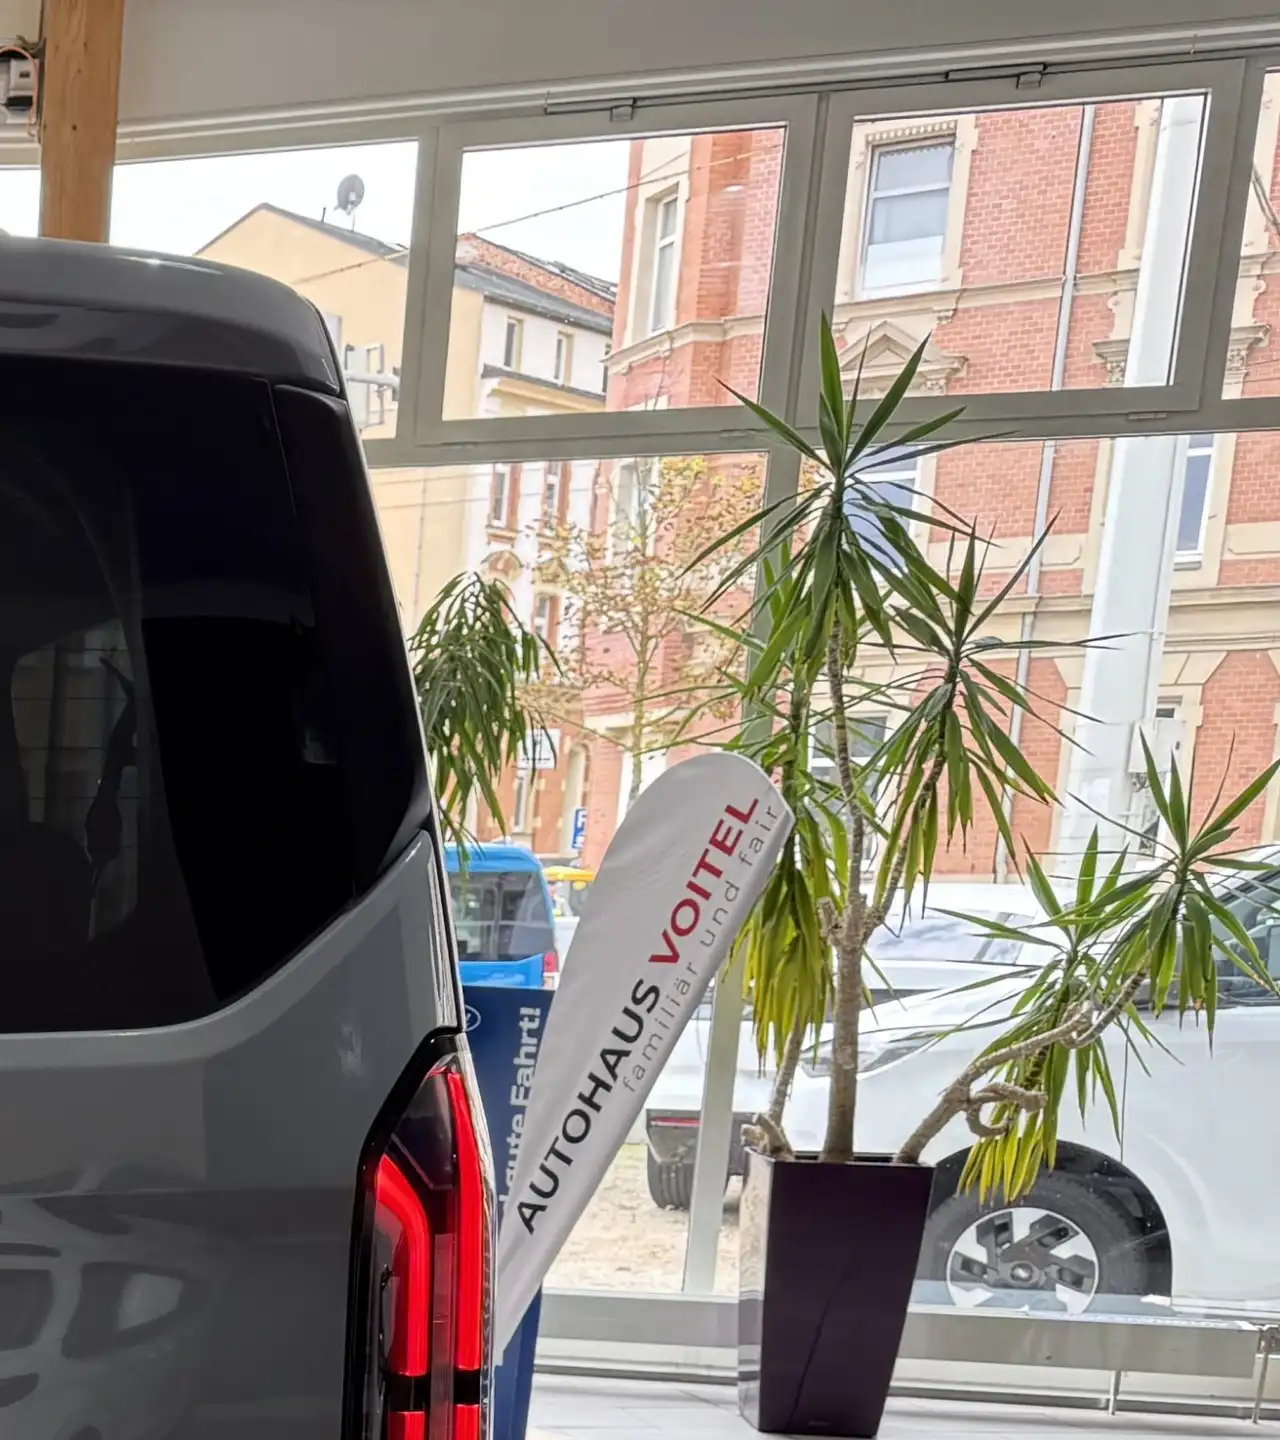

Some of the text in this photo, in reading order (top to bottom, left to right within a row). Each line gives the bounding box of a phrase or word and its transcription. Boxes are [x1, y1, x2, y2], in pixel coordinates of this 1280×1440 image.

[510, 1007, 541, 1106] Fahrt!
[517, 798, 760, 1235] AUTOHAUS VOITEL
[622, 805, 779, 1093] familiär und fair
